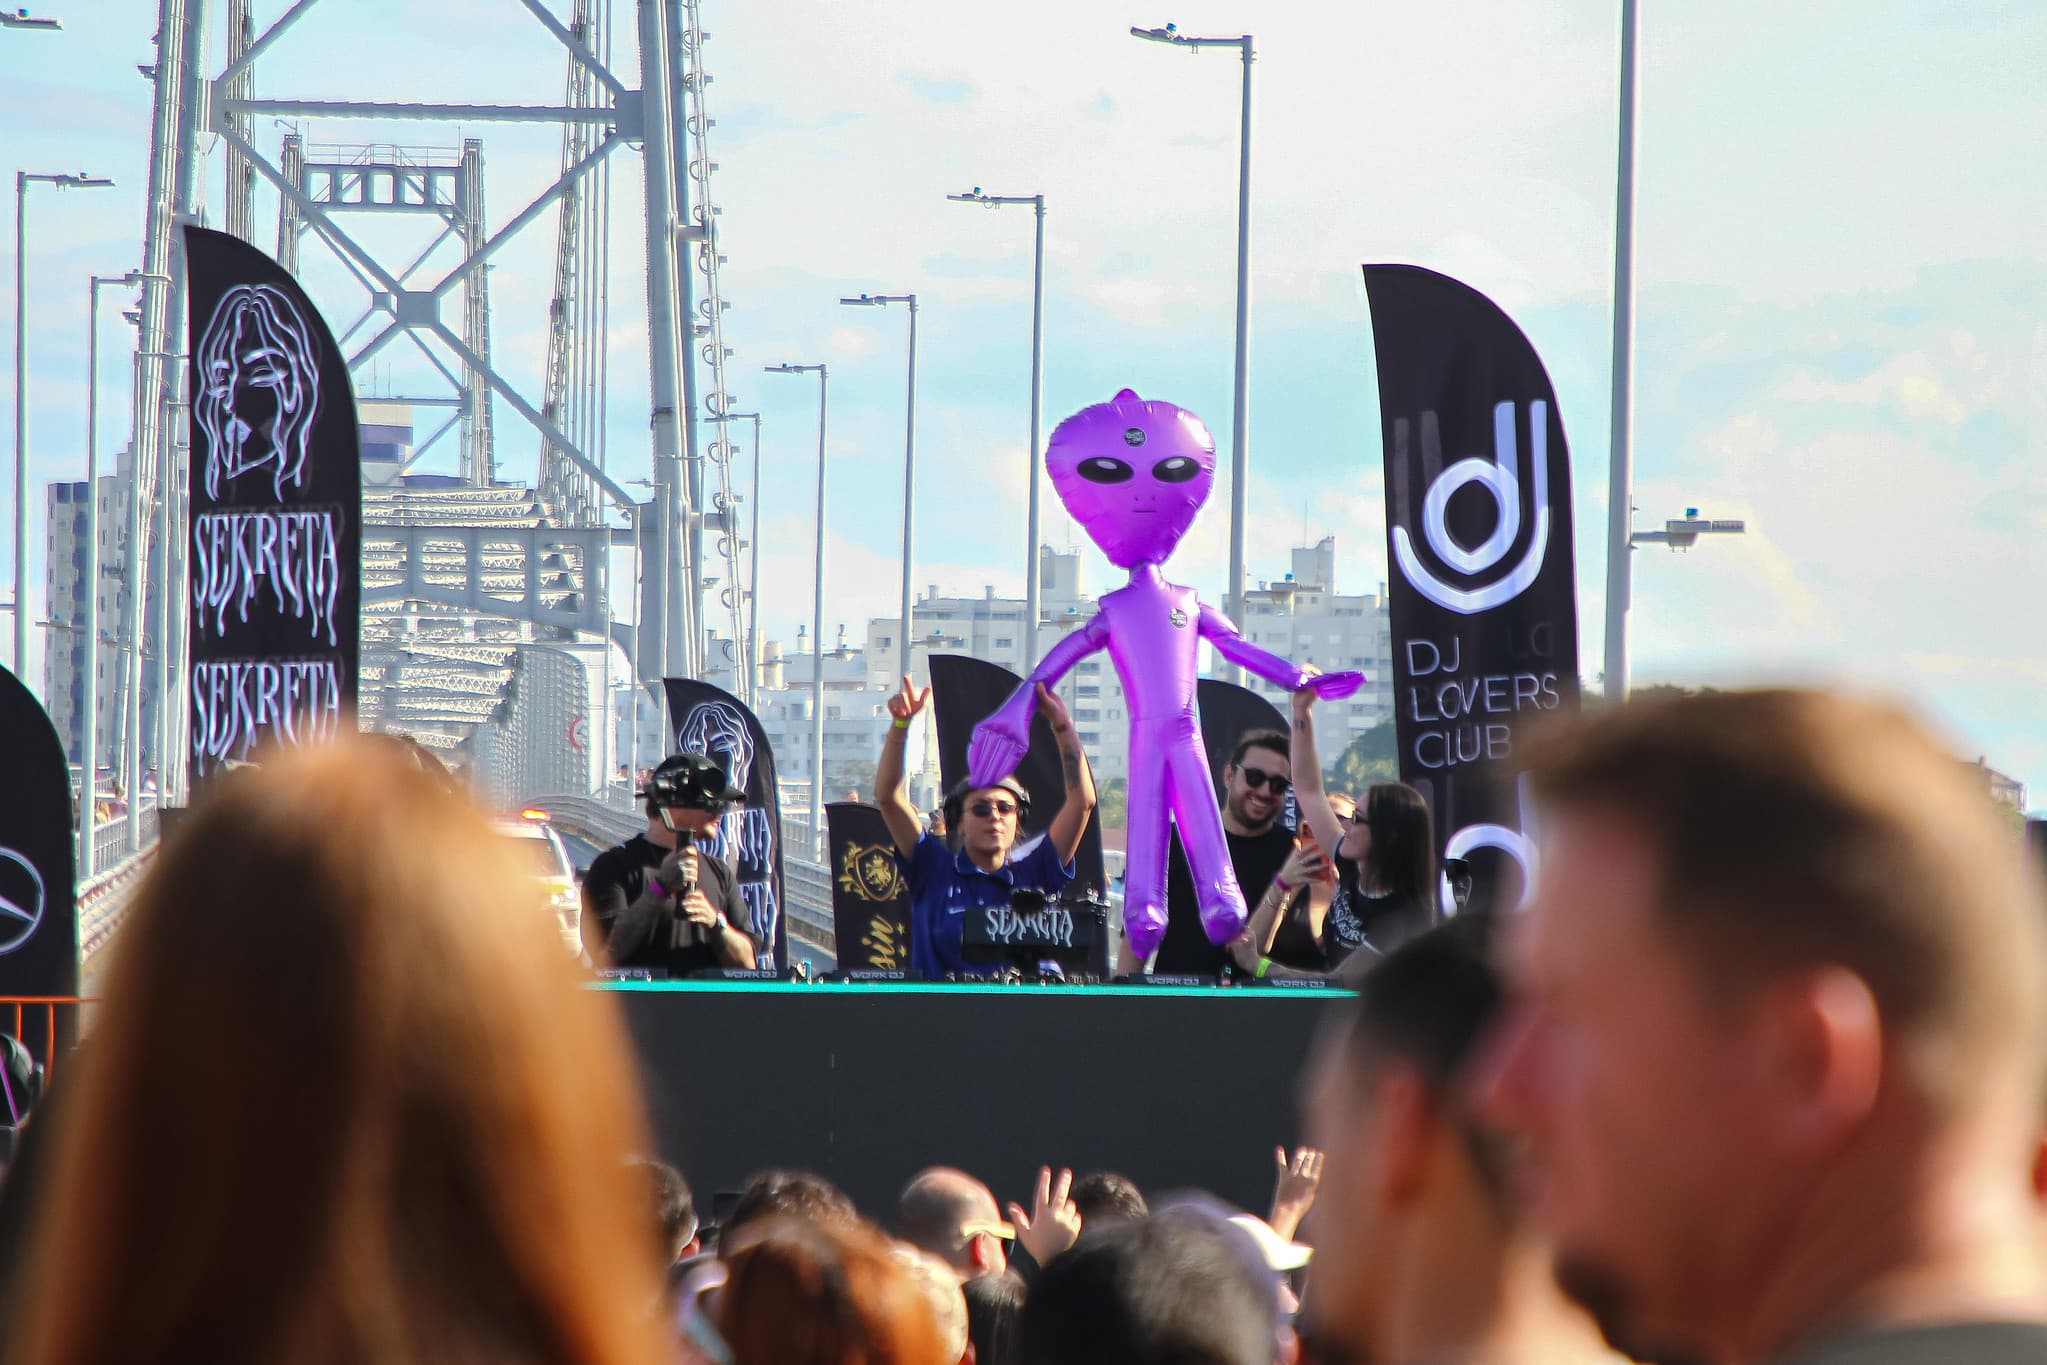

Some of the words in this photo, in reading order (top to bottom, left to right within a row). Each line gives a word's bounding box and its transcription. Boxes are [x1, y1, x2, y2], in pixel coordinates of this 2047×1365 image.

[194, 513, 338, 646] SEKRETA
[1406, 635, 1460, 676] DJ
[1411, 672, 1560, 722] LOVERS
[193, 662, 340, 777] SEKRETA
[1414, 722, 1512, 769] CLUB
[723, 970, 759, 978] WORK
[762, 970, 777, 978] DJ
[851, 971, 886, 979] WORK
[888, 971, 904, 979] DJ
[1146, 977, 1181, 985] WORK
[1272, 979, 1305, 987] WORK
